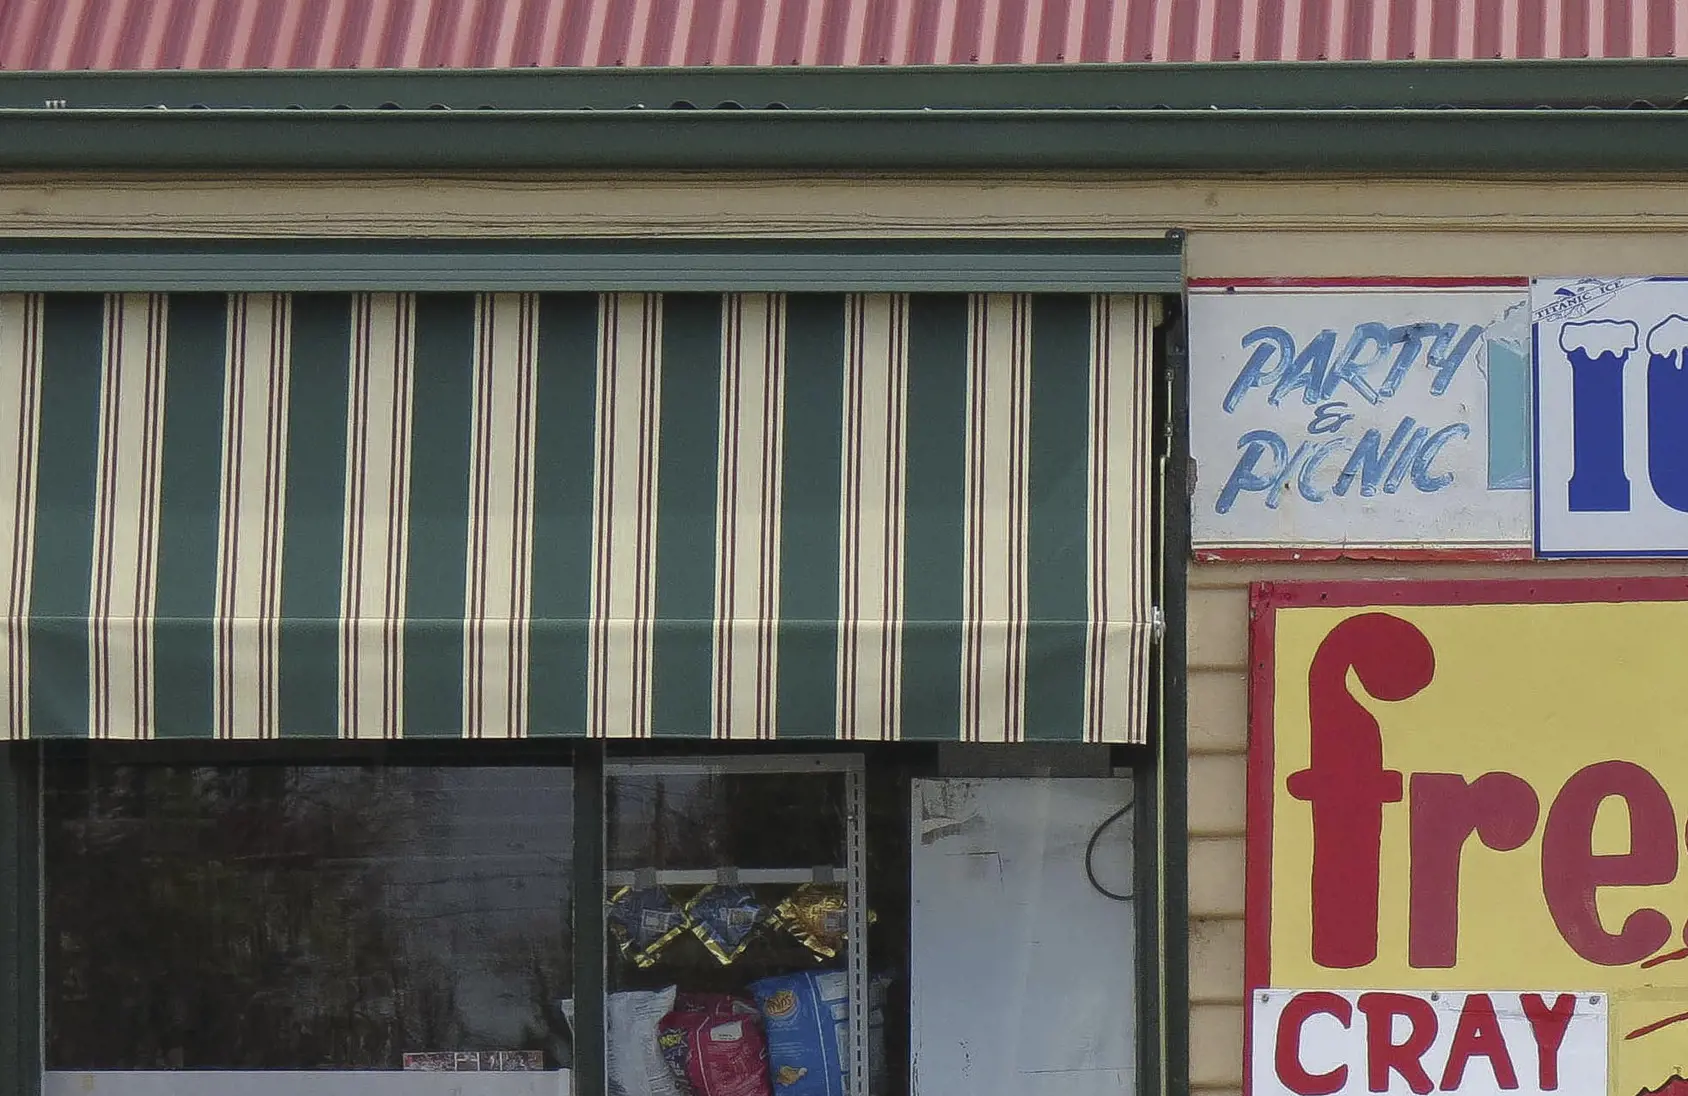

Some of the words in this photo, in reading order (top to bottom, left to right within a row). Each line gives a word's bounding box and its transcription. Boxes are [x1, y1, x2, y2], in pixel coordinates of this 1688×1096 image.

[1535, 292, 1592, 319] TITANIC
[1221, 321, 1484, 414] PARTY
[1306, 400, 1352, 435] &
[1214, 414, 1470, 515] PICNIC
[1274, 991, 1578, 1096] CRAY
